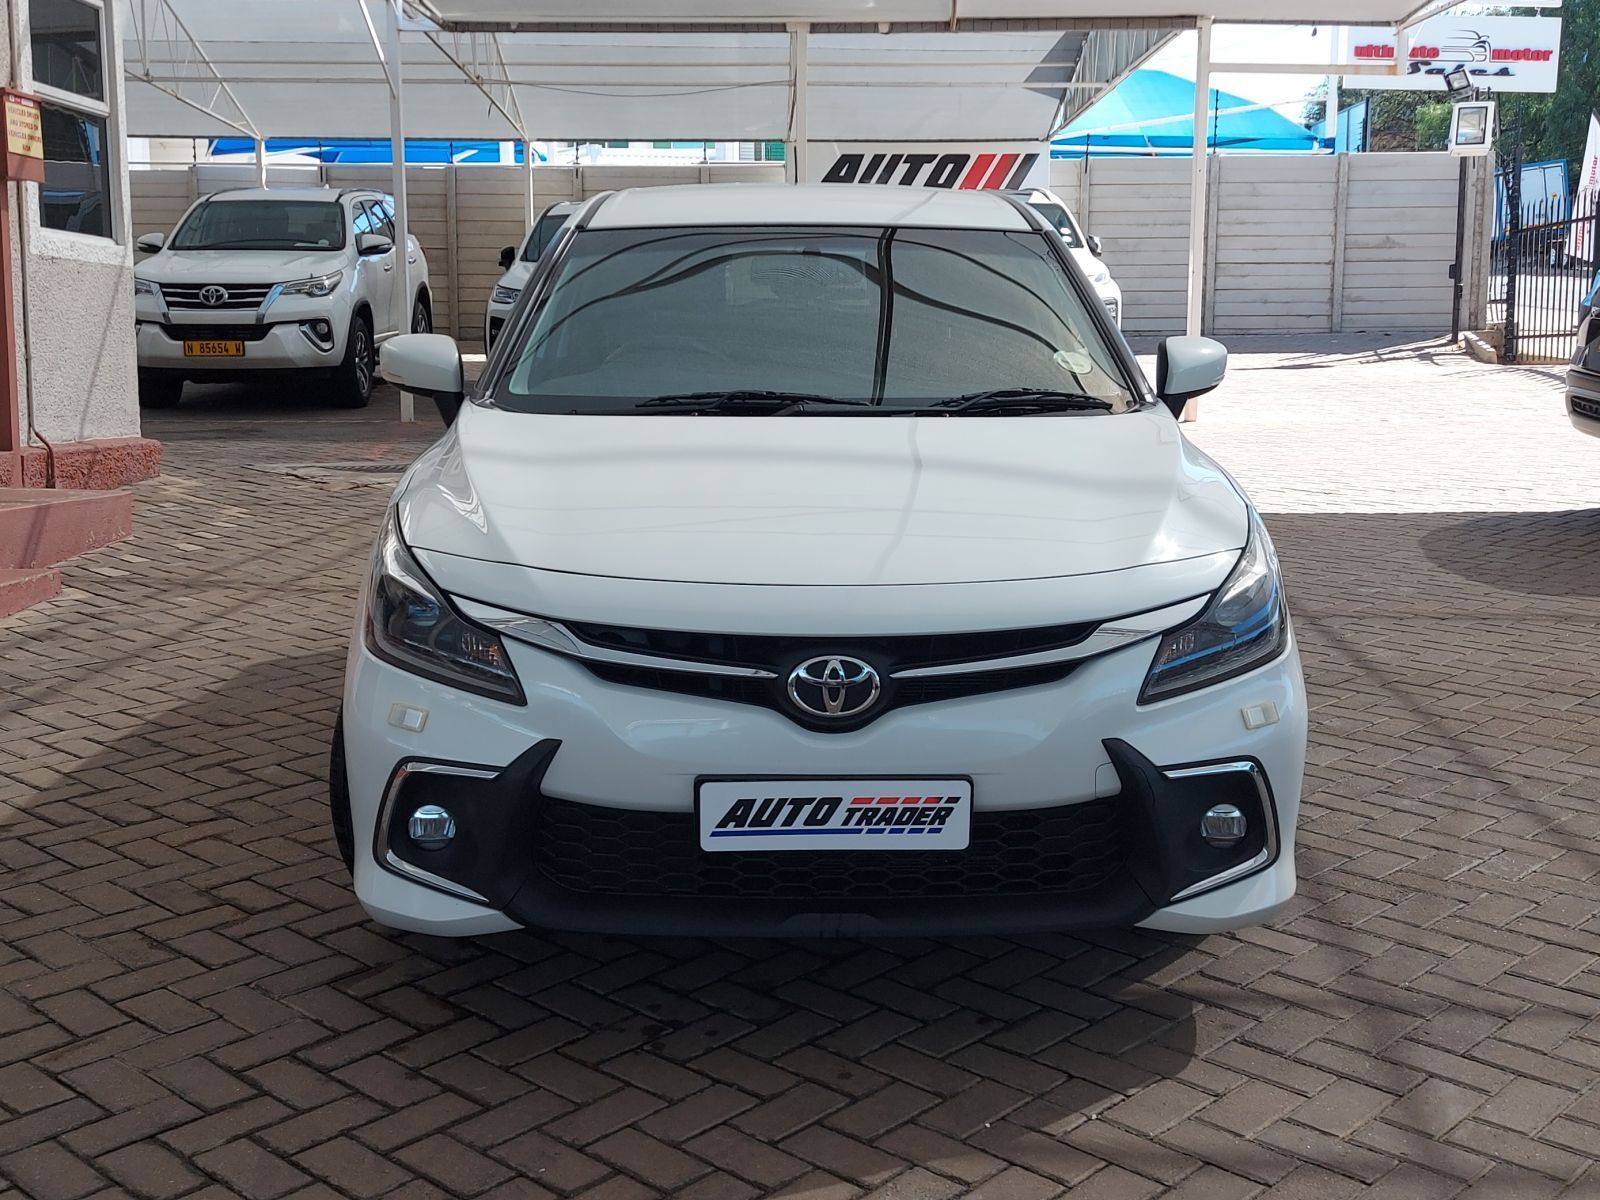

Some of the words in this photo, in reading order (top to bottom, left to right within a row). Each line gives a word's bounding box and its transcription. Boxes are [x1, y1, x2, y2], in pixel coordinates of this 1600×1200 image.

[1491, 48, 1553, 61] motor
[821, 153, 971, 188] AUTO
[187, 342, 193, 354] N
[200, 342, 229, 354] 85654
[235, 342, 241, 354] W
[715, 797, 843, 828] AUTO
[840, 806, 954, 826] TRADER
